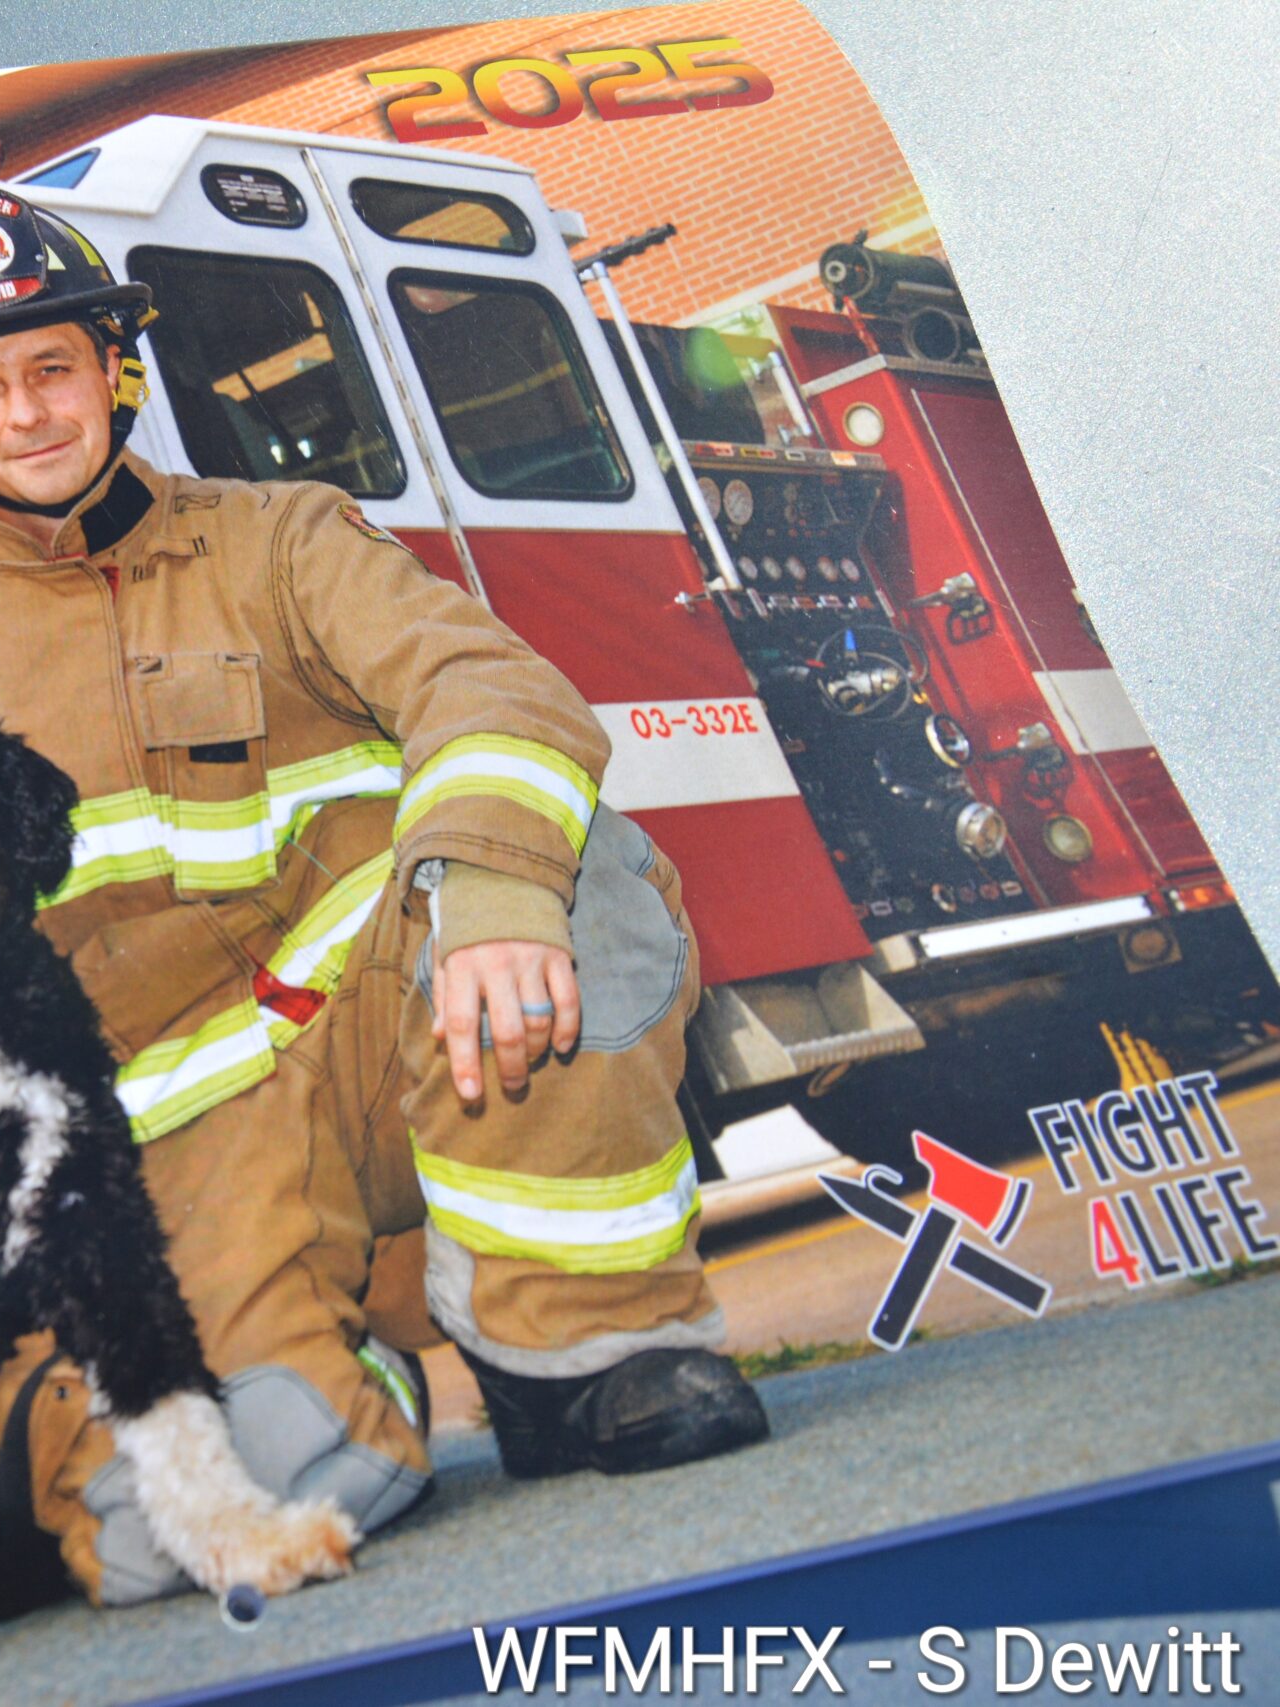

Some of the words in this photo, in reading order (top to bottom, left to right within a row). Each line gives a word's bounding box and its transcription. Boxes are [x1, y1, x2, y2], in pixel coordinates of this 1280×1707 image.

[366, 36, 774, 143] 2025
[630, 703, 759, 740] 03-332E
[1027, 1070, 1240, 1195] FIGHT
[1088, 1165, 1280, 1291] 4LIFE
